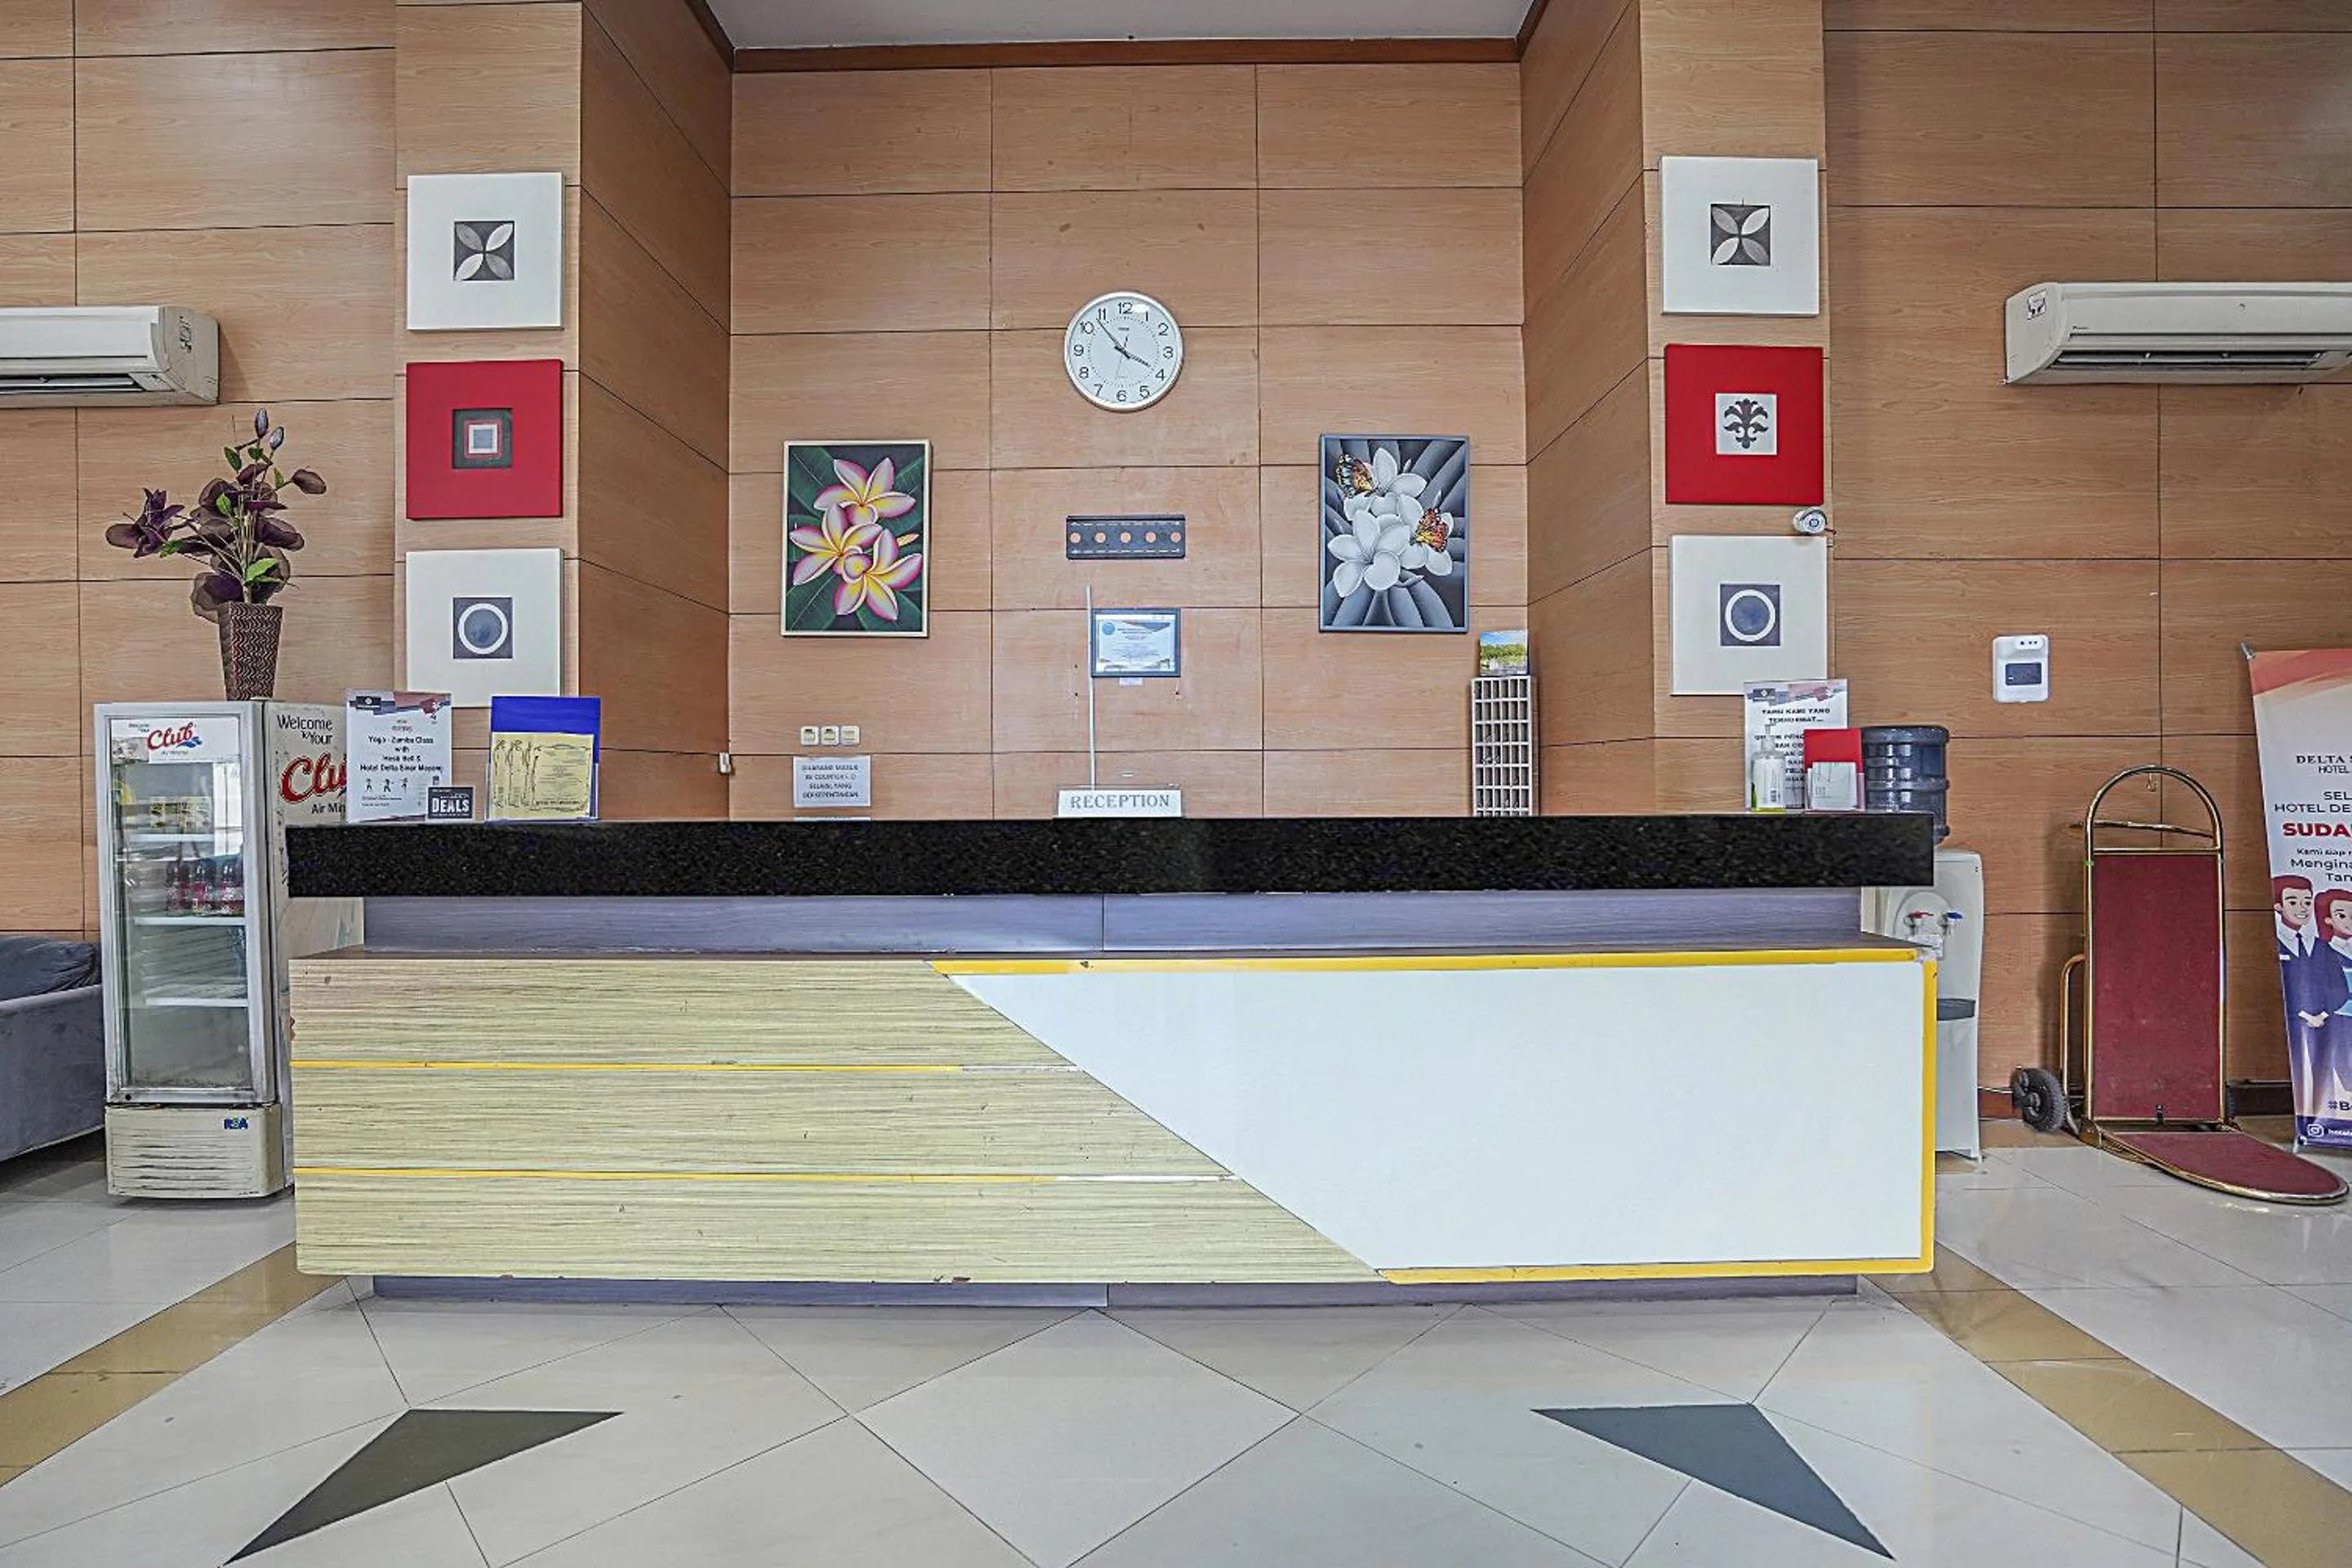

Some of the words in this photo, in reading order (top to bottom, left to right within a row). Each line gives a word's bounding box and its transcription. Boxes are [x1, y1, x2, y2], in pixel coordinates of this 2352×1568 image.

[1098, 308, 1107, 320] 11
[1118, 302, 1133, 314] 12
[1145, 311, 1150, 322] 1
[1080, 321, 1094, 335] 10
[1158, 323, 1169, 336] 2
[1073, 345, 1085, 357] 9
[1163, 346, 1174, 359] 3
[1079, 367, 1089, 379] 8
[1156, 369, 1165, 381] 4
[1094, 384, 1103, 397] 7
[1116, 390, 1127, 402] 6
[1139, 385, 1150, 399] 5
[277, 714, 333, 731] Welcome
[148, 722, 194, 750] Club
[2296, 755, 2345, 764] DELTA
[2319, 765, 2349, 773] HOTEL
[278, 751, 346, 804] Clu
[1071, 795, 1169, 808] RECEPTION
[2323, 791, 2352, 800] SEL
[431, 797, 470, 813] DEALS
[2274, 804, 2325, 813] HOTEL
[2329, 804, 2352, 813] DE
[2283, 822, 2351, 837] SUDA
